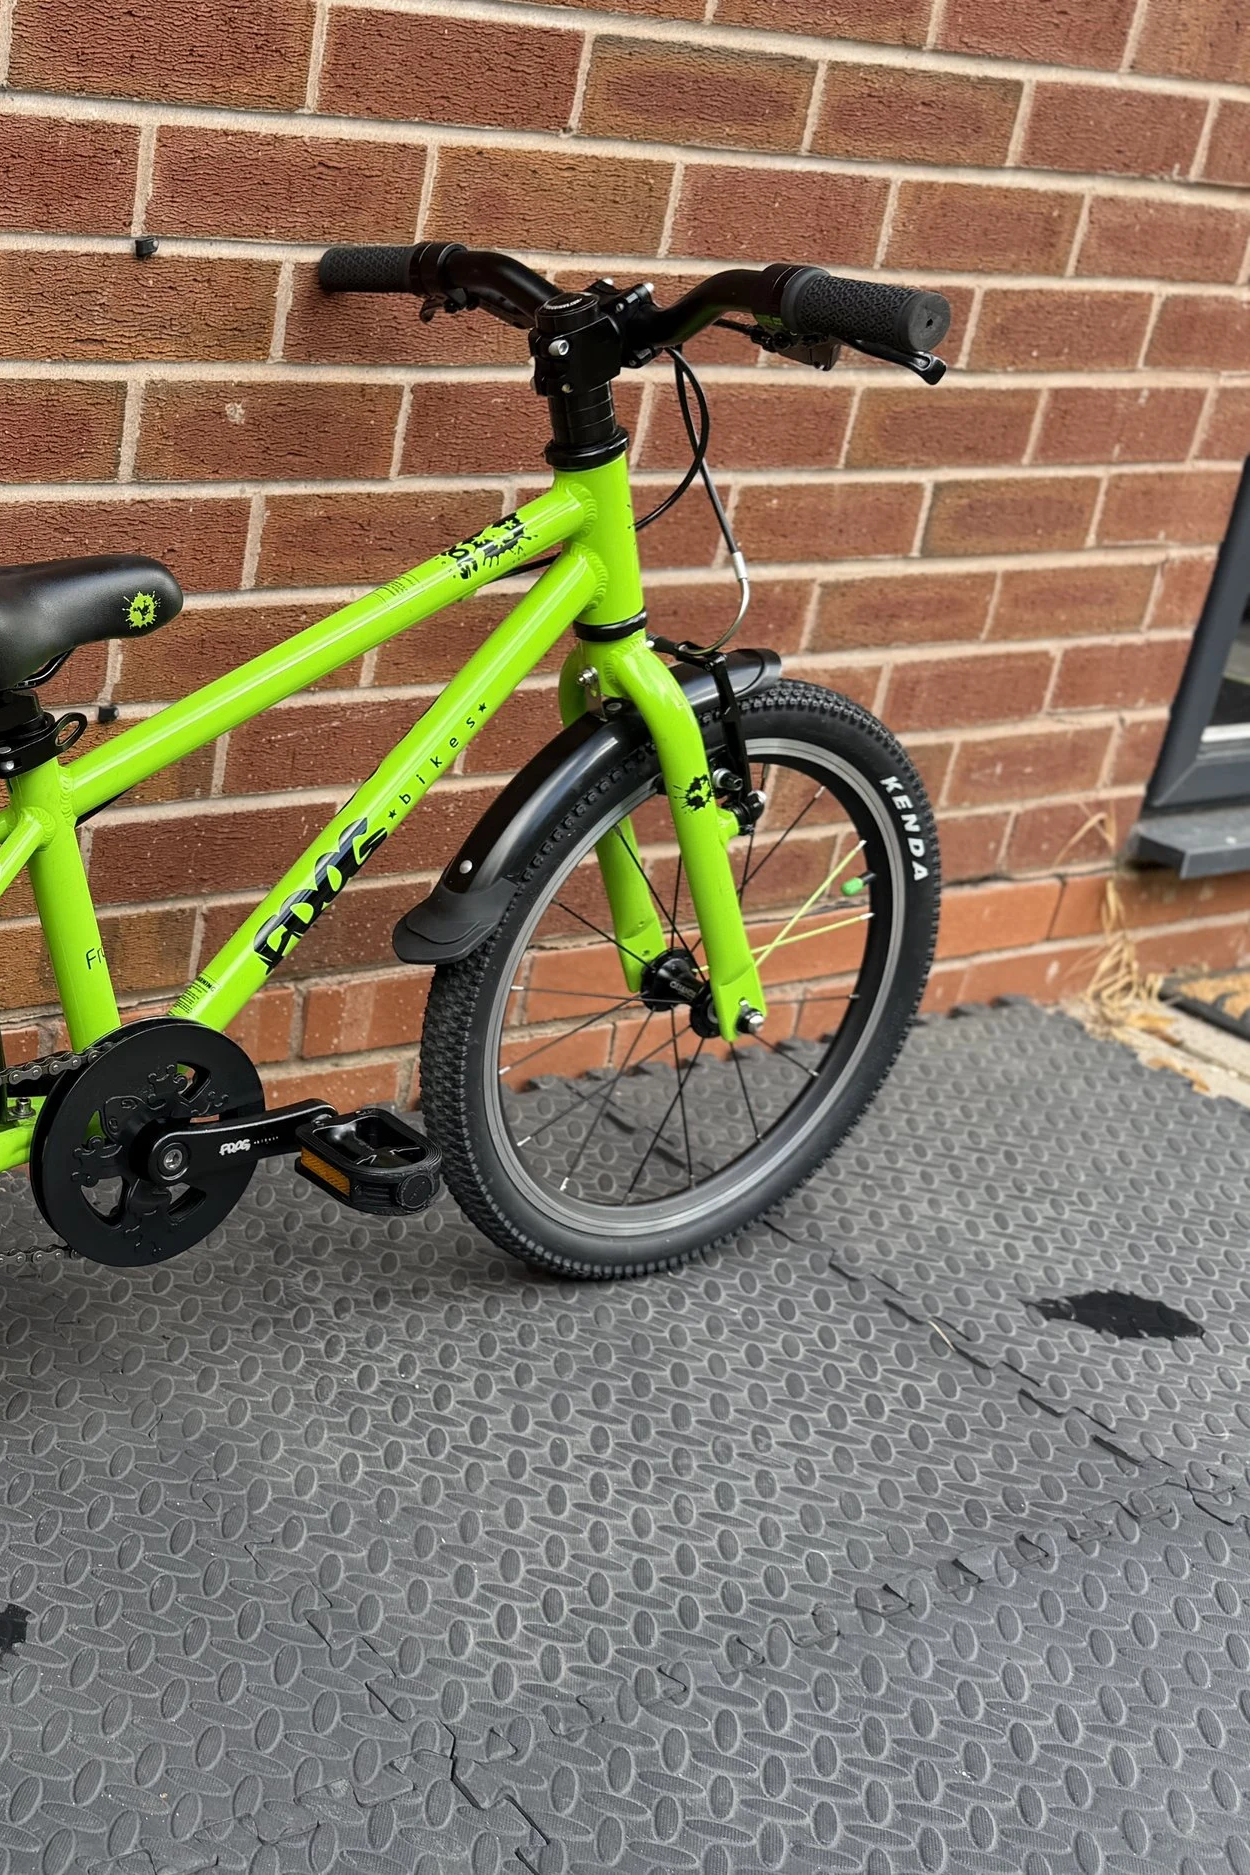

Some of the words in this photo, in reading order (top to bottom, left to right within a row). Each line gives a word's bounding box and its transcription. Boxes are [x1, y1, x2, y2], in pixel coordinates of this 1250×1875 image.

[252, 816, 389, 976] FROG
[398, 715, 477, 806] bikes
[879, 775, 930, 882] KENDA
[218, 1138, 252, 1156] FROG
